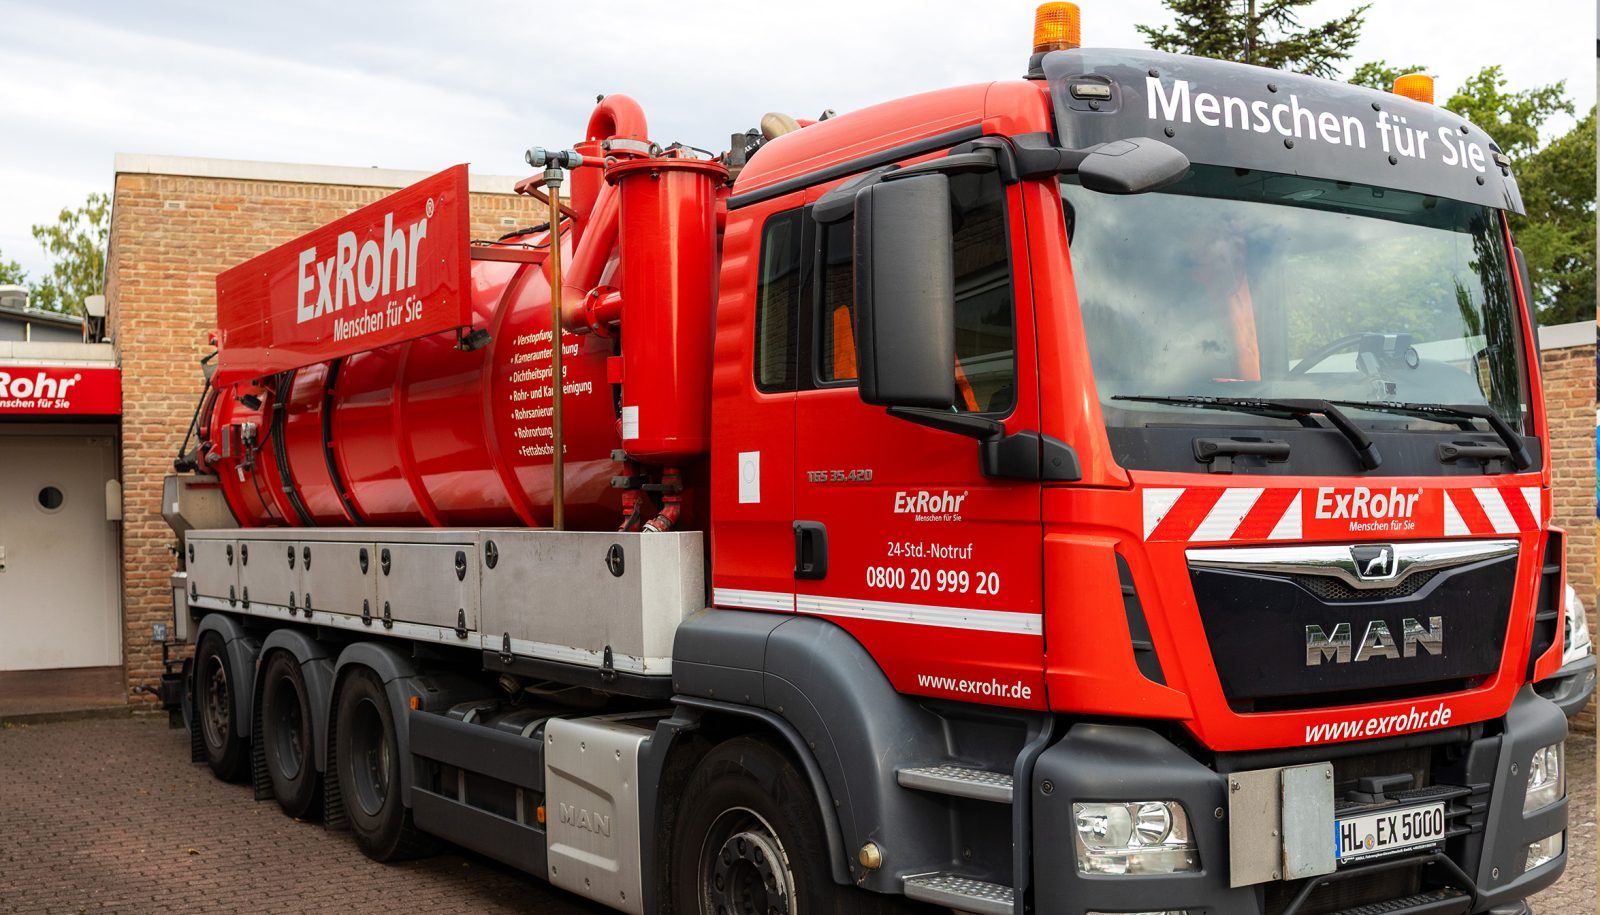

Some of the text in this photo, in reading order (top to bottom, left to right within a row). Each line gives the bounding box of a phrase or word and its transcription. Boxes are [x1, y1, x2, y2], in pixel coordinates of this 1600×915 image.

[1145, 76, 1486, 173] Menschen für Sie
[333, 294, 423, 342] Menschen für Sie
[513, 364, 567, 383] Dichtheitsprüg
[37, 398, 53, 408] für
[54, 399, 70, 409] Sie
[530, 385, 543, 399] und
[807, 468, 873, 482] TGS 35.420
[915, 513, 962, 522] Menschen für Sie
[1349, 519, 1415, 532] Menschen für Sie
[887, 541, 973, 560] 24-Std.-Notruf
[866, 566, 1000, 595] 0800 20 999 20
[1305, 615, 1443, 667] MAN
[917, 674, 1032, 700] www.exrohr.de
[1305, 703, 1452, 743] www.exrohr.de
[558, 802, 612, 837] MAN
[1341, 823, 1363, 853] HL
[1377, 815, 1398, 846] EX
[1402, 807, 1443, 841] 5000
